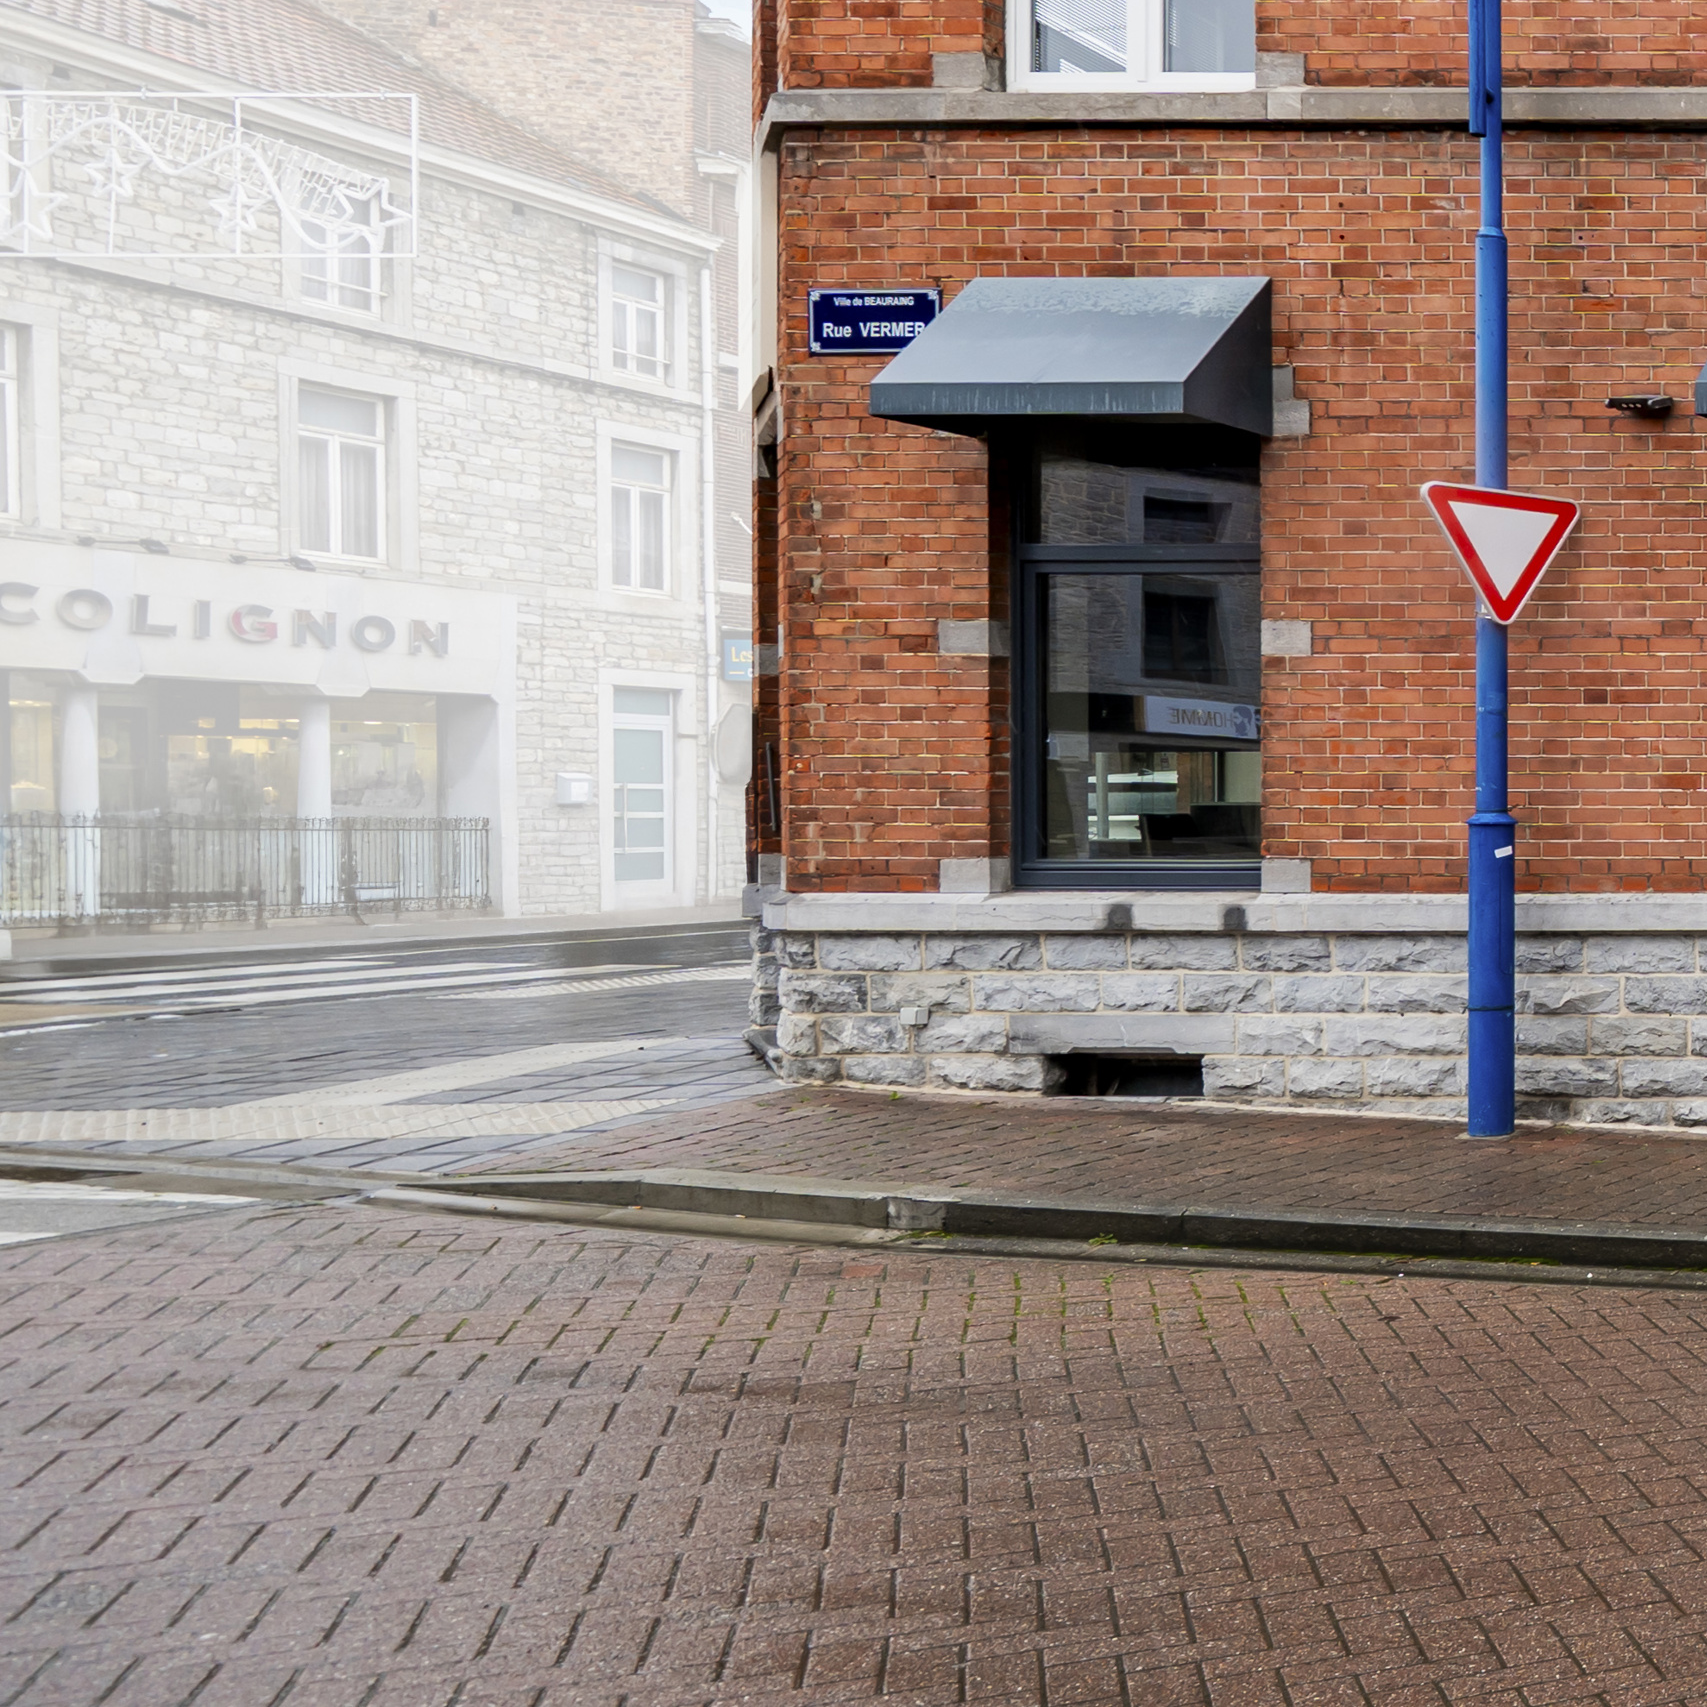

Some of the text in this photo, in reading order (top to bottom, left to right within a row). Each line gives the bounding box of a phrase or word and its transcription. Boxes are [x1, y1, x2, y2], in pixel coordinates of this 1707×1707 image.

[833, 296, 914, 306] Ville de BEAURAING
[822, 321, 925, 337] Rue VERMER
[0, 581, 450, 657] COLIGNON
